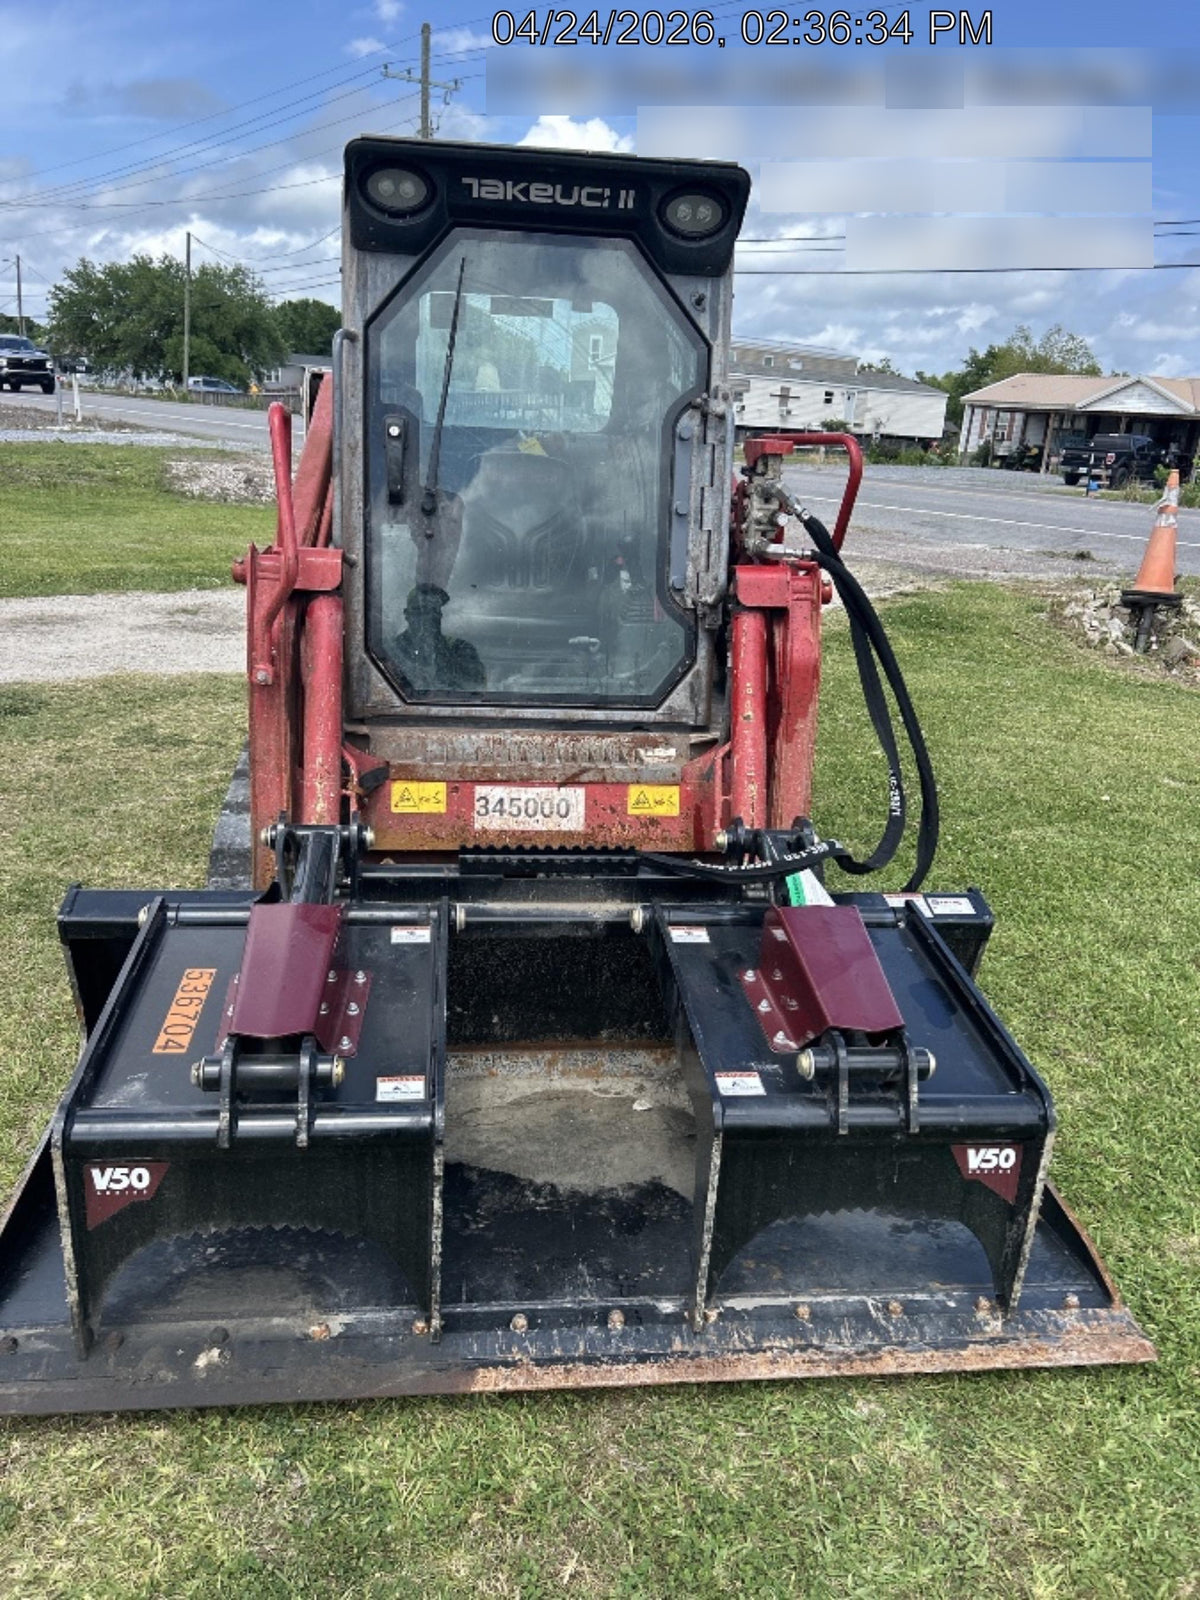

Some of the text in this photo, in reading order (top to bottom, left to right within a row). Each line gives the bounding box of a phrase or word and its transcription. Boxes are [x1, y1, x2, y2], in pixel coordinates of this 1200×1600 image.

[475, 796, 571, 819] 345000
[156, 970, 215, 1053] 536704
[966, 1147, 1018, 1170] V50
[90, 1167, 151, 1191] V50
